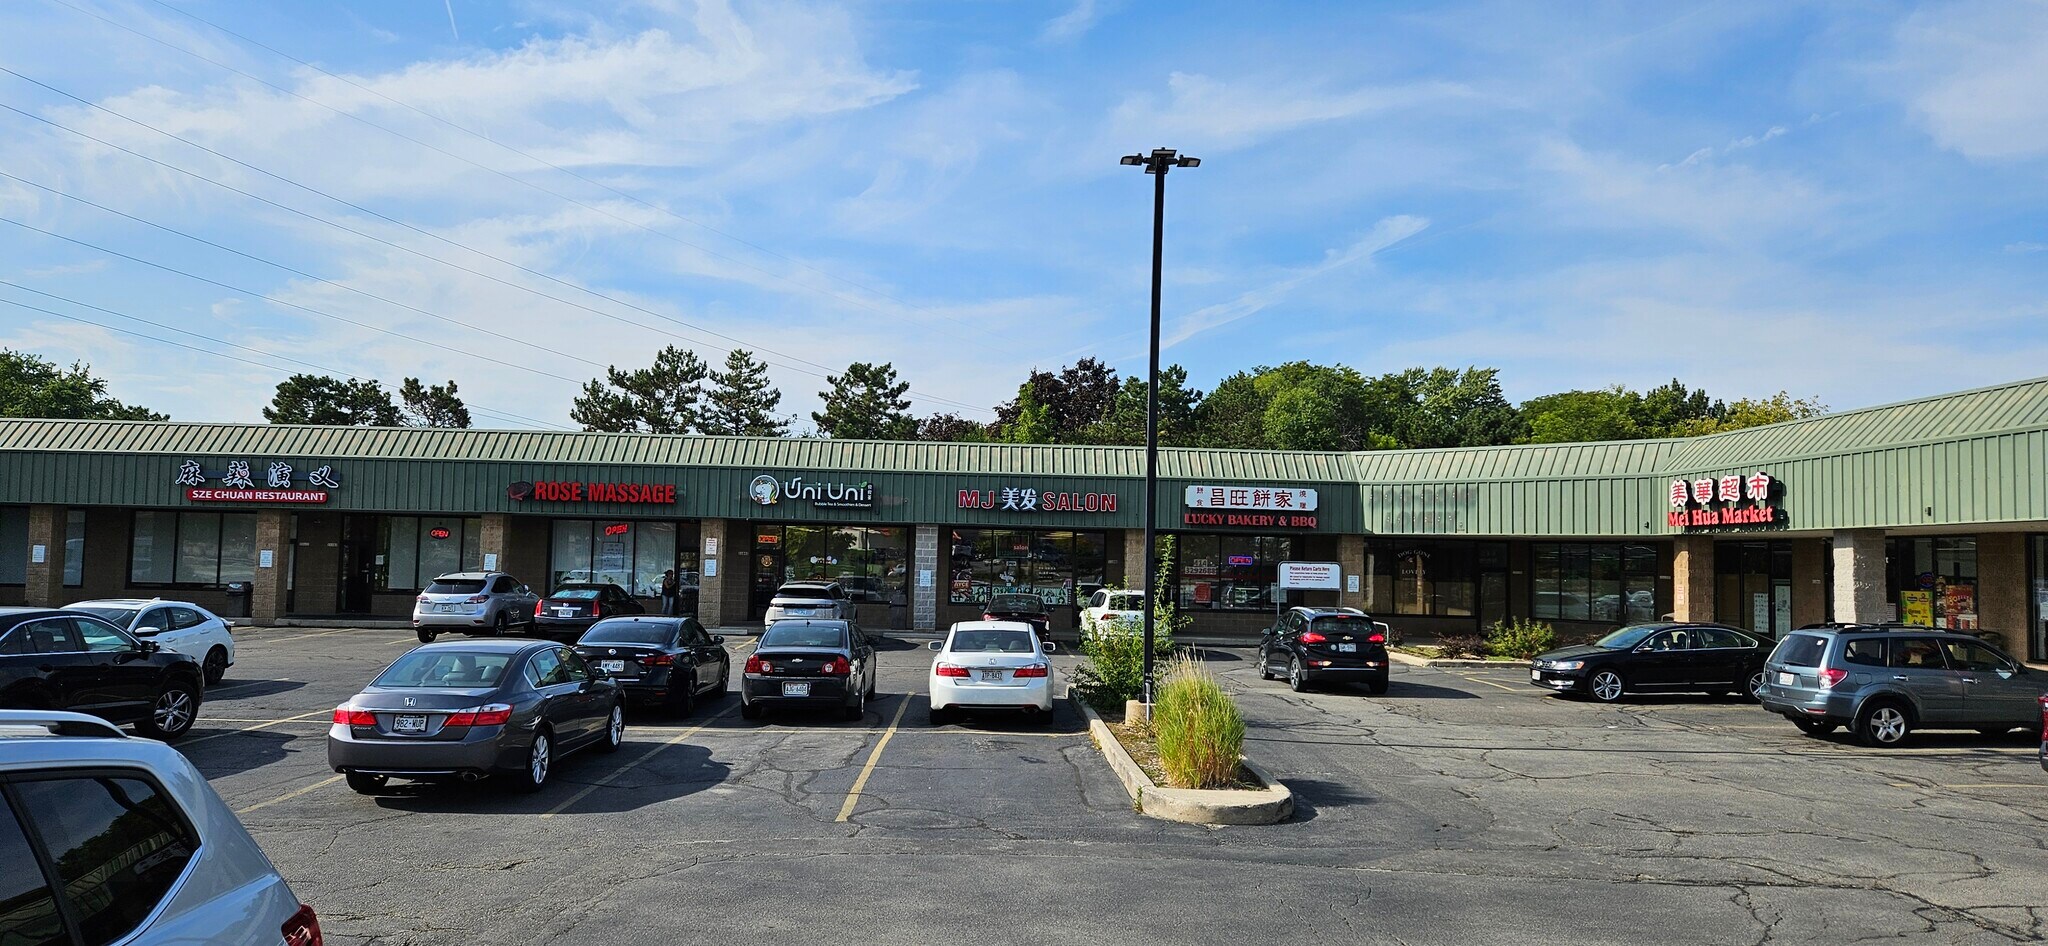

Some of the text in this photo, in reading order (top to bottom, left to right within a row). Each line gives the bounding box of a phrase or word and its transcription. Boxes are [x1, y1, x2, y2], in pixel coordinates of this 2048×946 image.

[175, 460, 339, 489] 麻辣演义
[192, 490, 326, 501] SZE CHUAN RESTAURANT
[535, 481, 676, 503] ROSE MASSAGE
[958, 489, 995, 509] MJ
[1001, 487, 1037, 512] 美发
[1210, 488, 1293, 508] 昌旺餅家
[1671, 471, 1769, 508] 美華超市
[1042, 491, 1117, 512] SALON
[1184, 513, 1317, 528] LUCKY BAKERY & BBQ
[1668, 505, 1773, 527] Mei Hua Market
[430, 529, 449, 539] OPEN
[605, 523, 628, 536] OPEN
